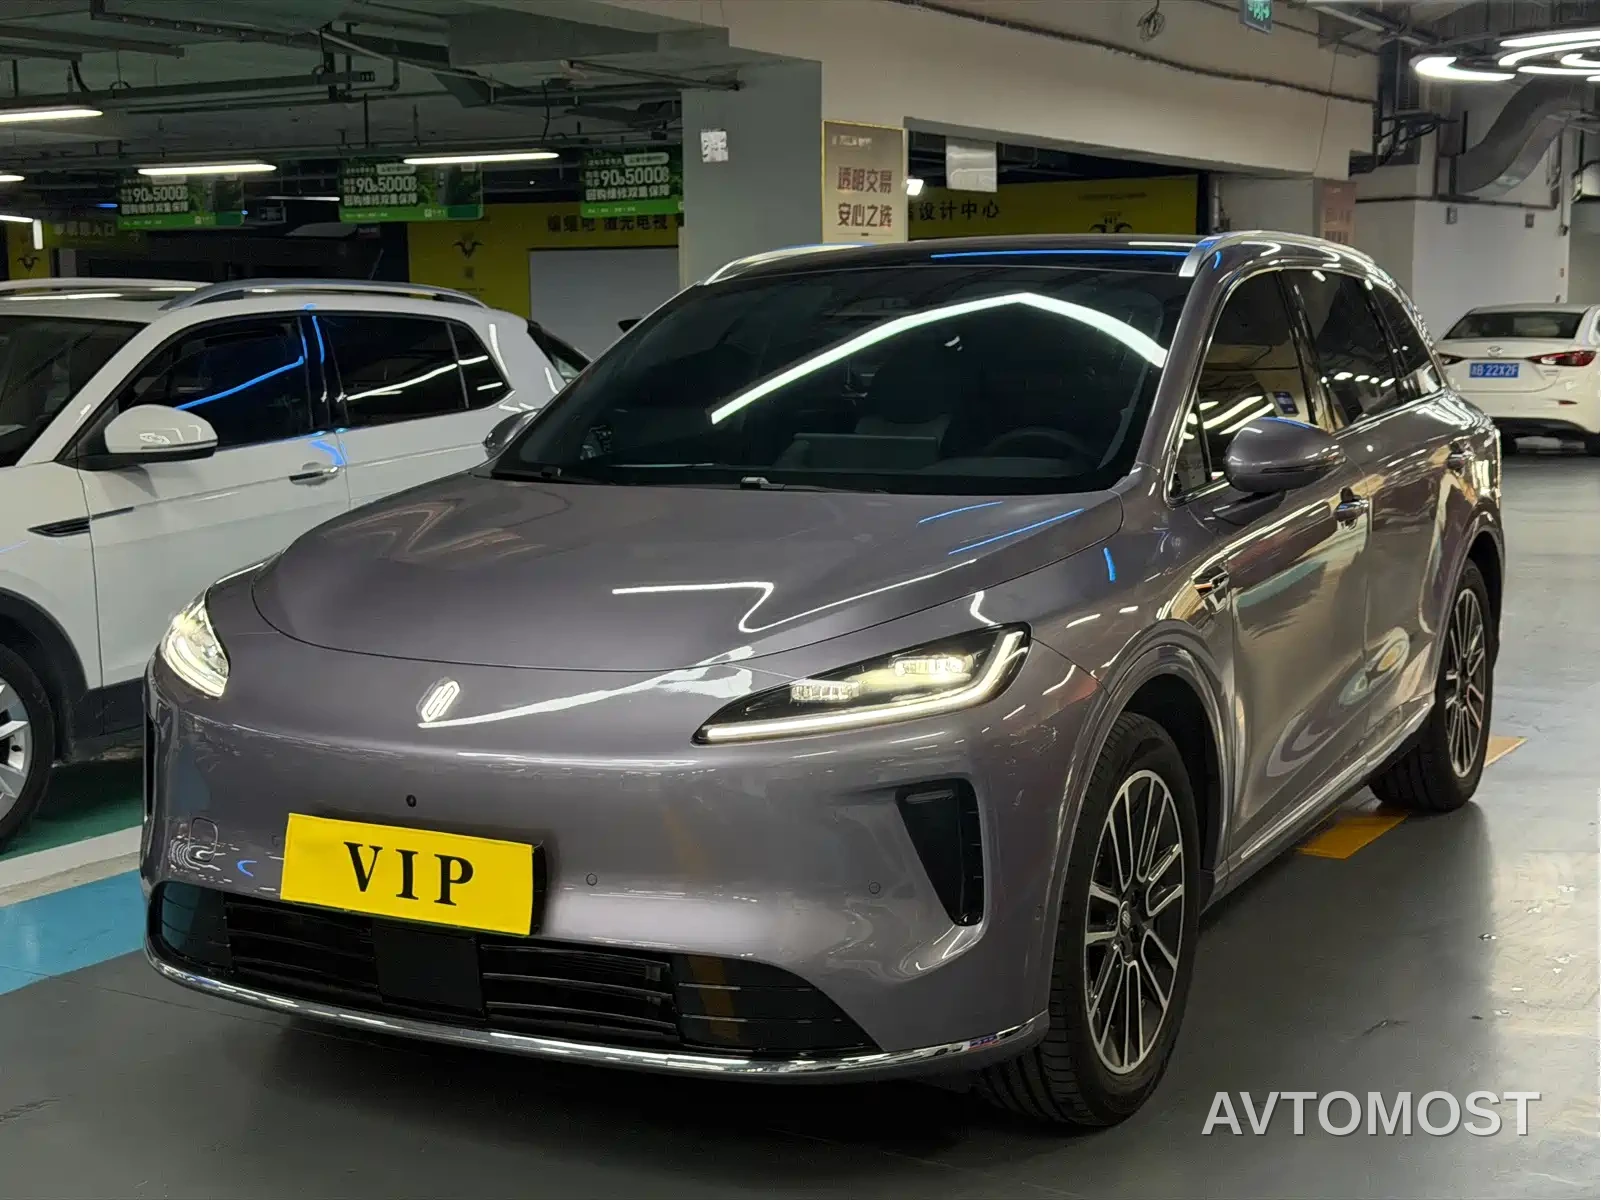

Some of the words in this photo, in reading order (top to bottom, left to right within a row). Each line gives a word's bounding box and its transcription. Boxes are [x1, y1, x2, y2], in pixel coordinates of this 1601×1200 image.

[837, 166, 893, 194] 透明交易
[837, 202, 893, 227] 安心之选
[343, 842, 474, 906] VIP
